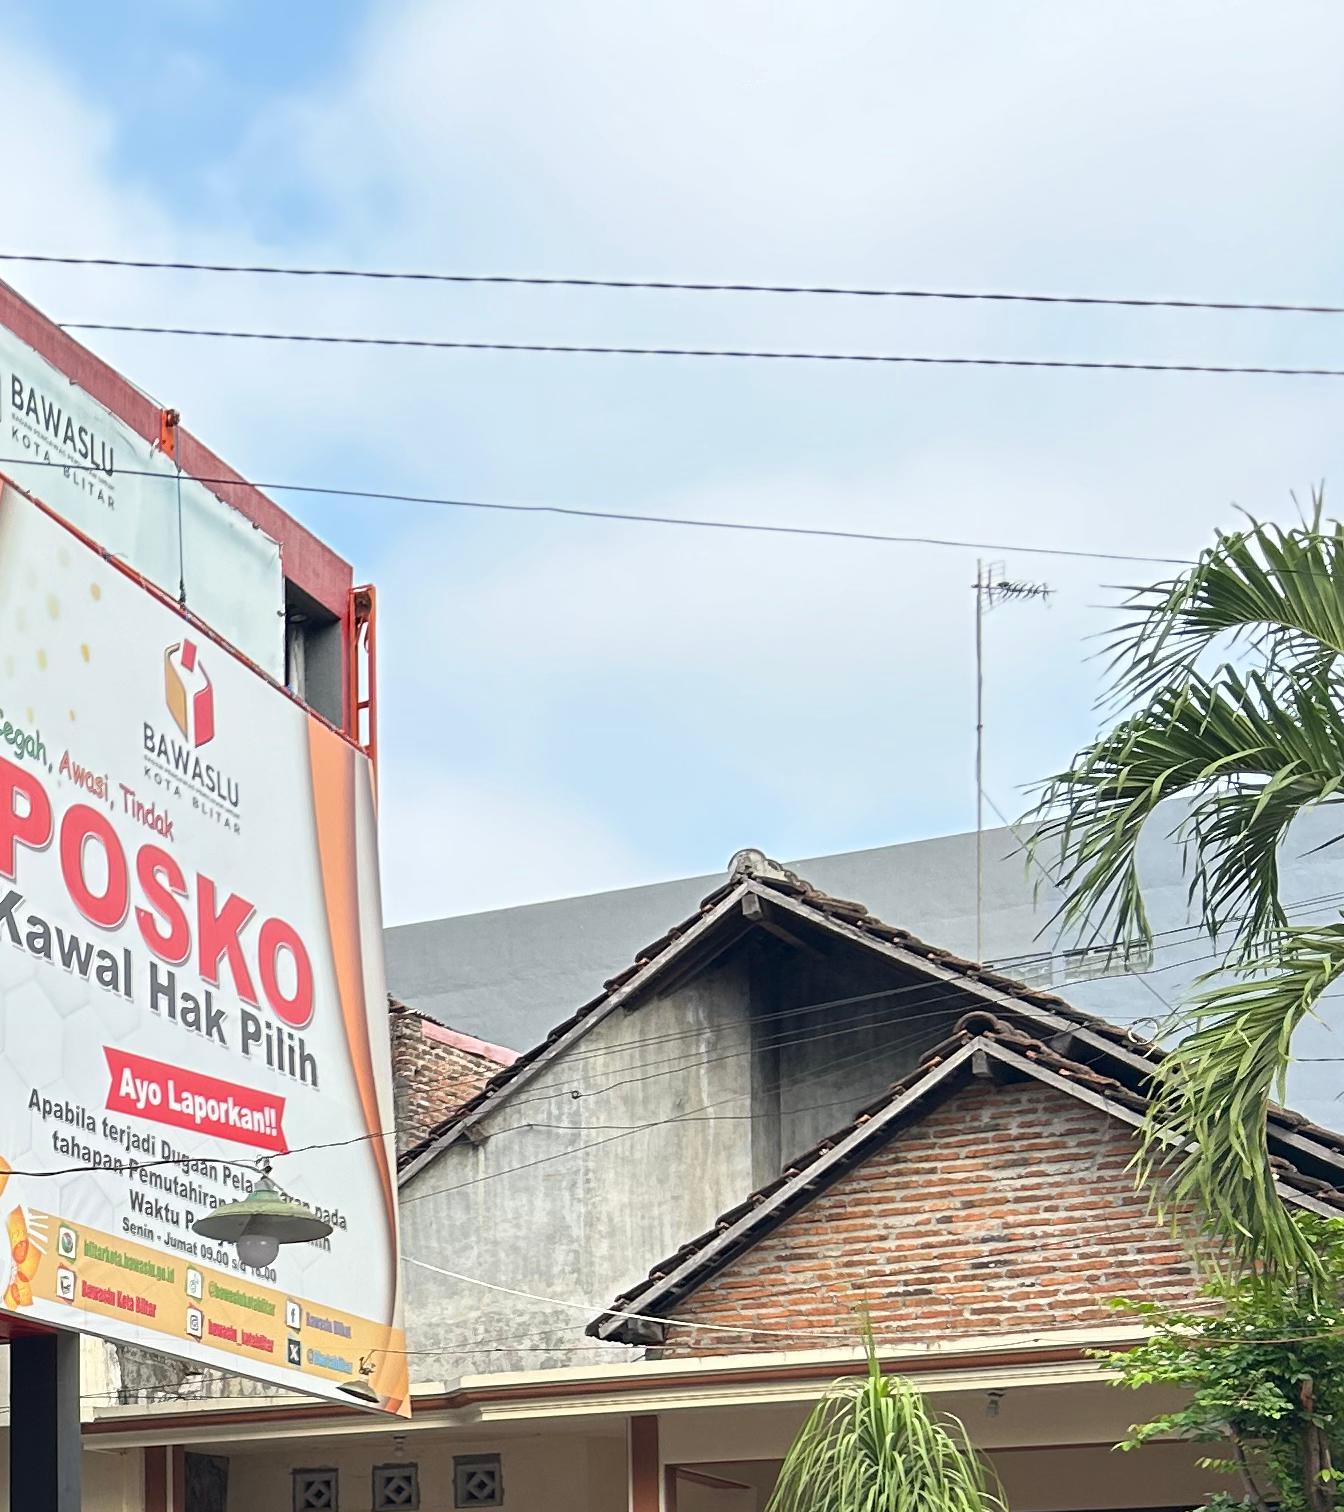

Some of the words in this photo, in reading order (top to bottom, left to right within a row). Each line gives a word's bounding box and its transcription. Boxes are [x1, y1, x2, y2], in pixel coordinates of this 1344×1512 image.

[12, 373, 113, 476] BAWASLU
[12, 426, 51, 464] KOTA
[64, 465, 115, 510] BLITAR
[143, 721, 239, 808] BAWASLU
[119, 782, 174, 842] Tindak
[143, 765, 182, 799] KOTA
[192, 796, 240, 836] BLITAR
[149, 960, 228, 1047] Hak
[239, 1007, 320, 1090] Pilih
[28, 1088, 96, 1133] Apabila
[101, 1118, 156, 1157] terjadi
[161, 1139, 218, 1182] Dugaan
[119, 1067, 162, 1110] Ayo
[167, 1080, 278, 1137] Laporkan!!
[52, 1130, 123, 1176] tahapan
[122, 1216, 154, 1241] Senin
[164, 1232, 198, 1256] Jumat
[200, 1244, 229, 1266] 09.00
[129, 1188, 180, 1226] Waktu
